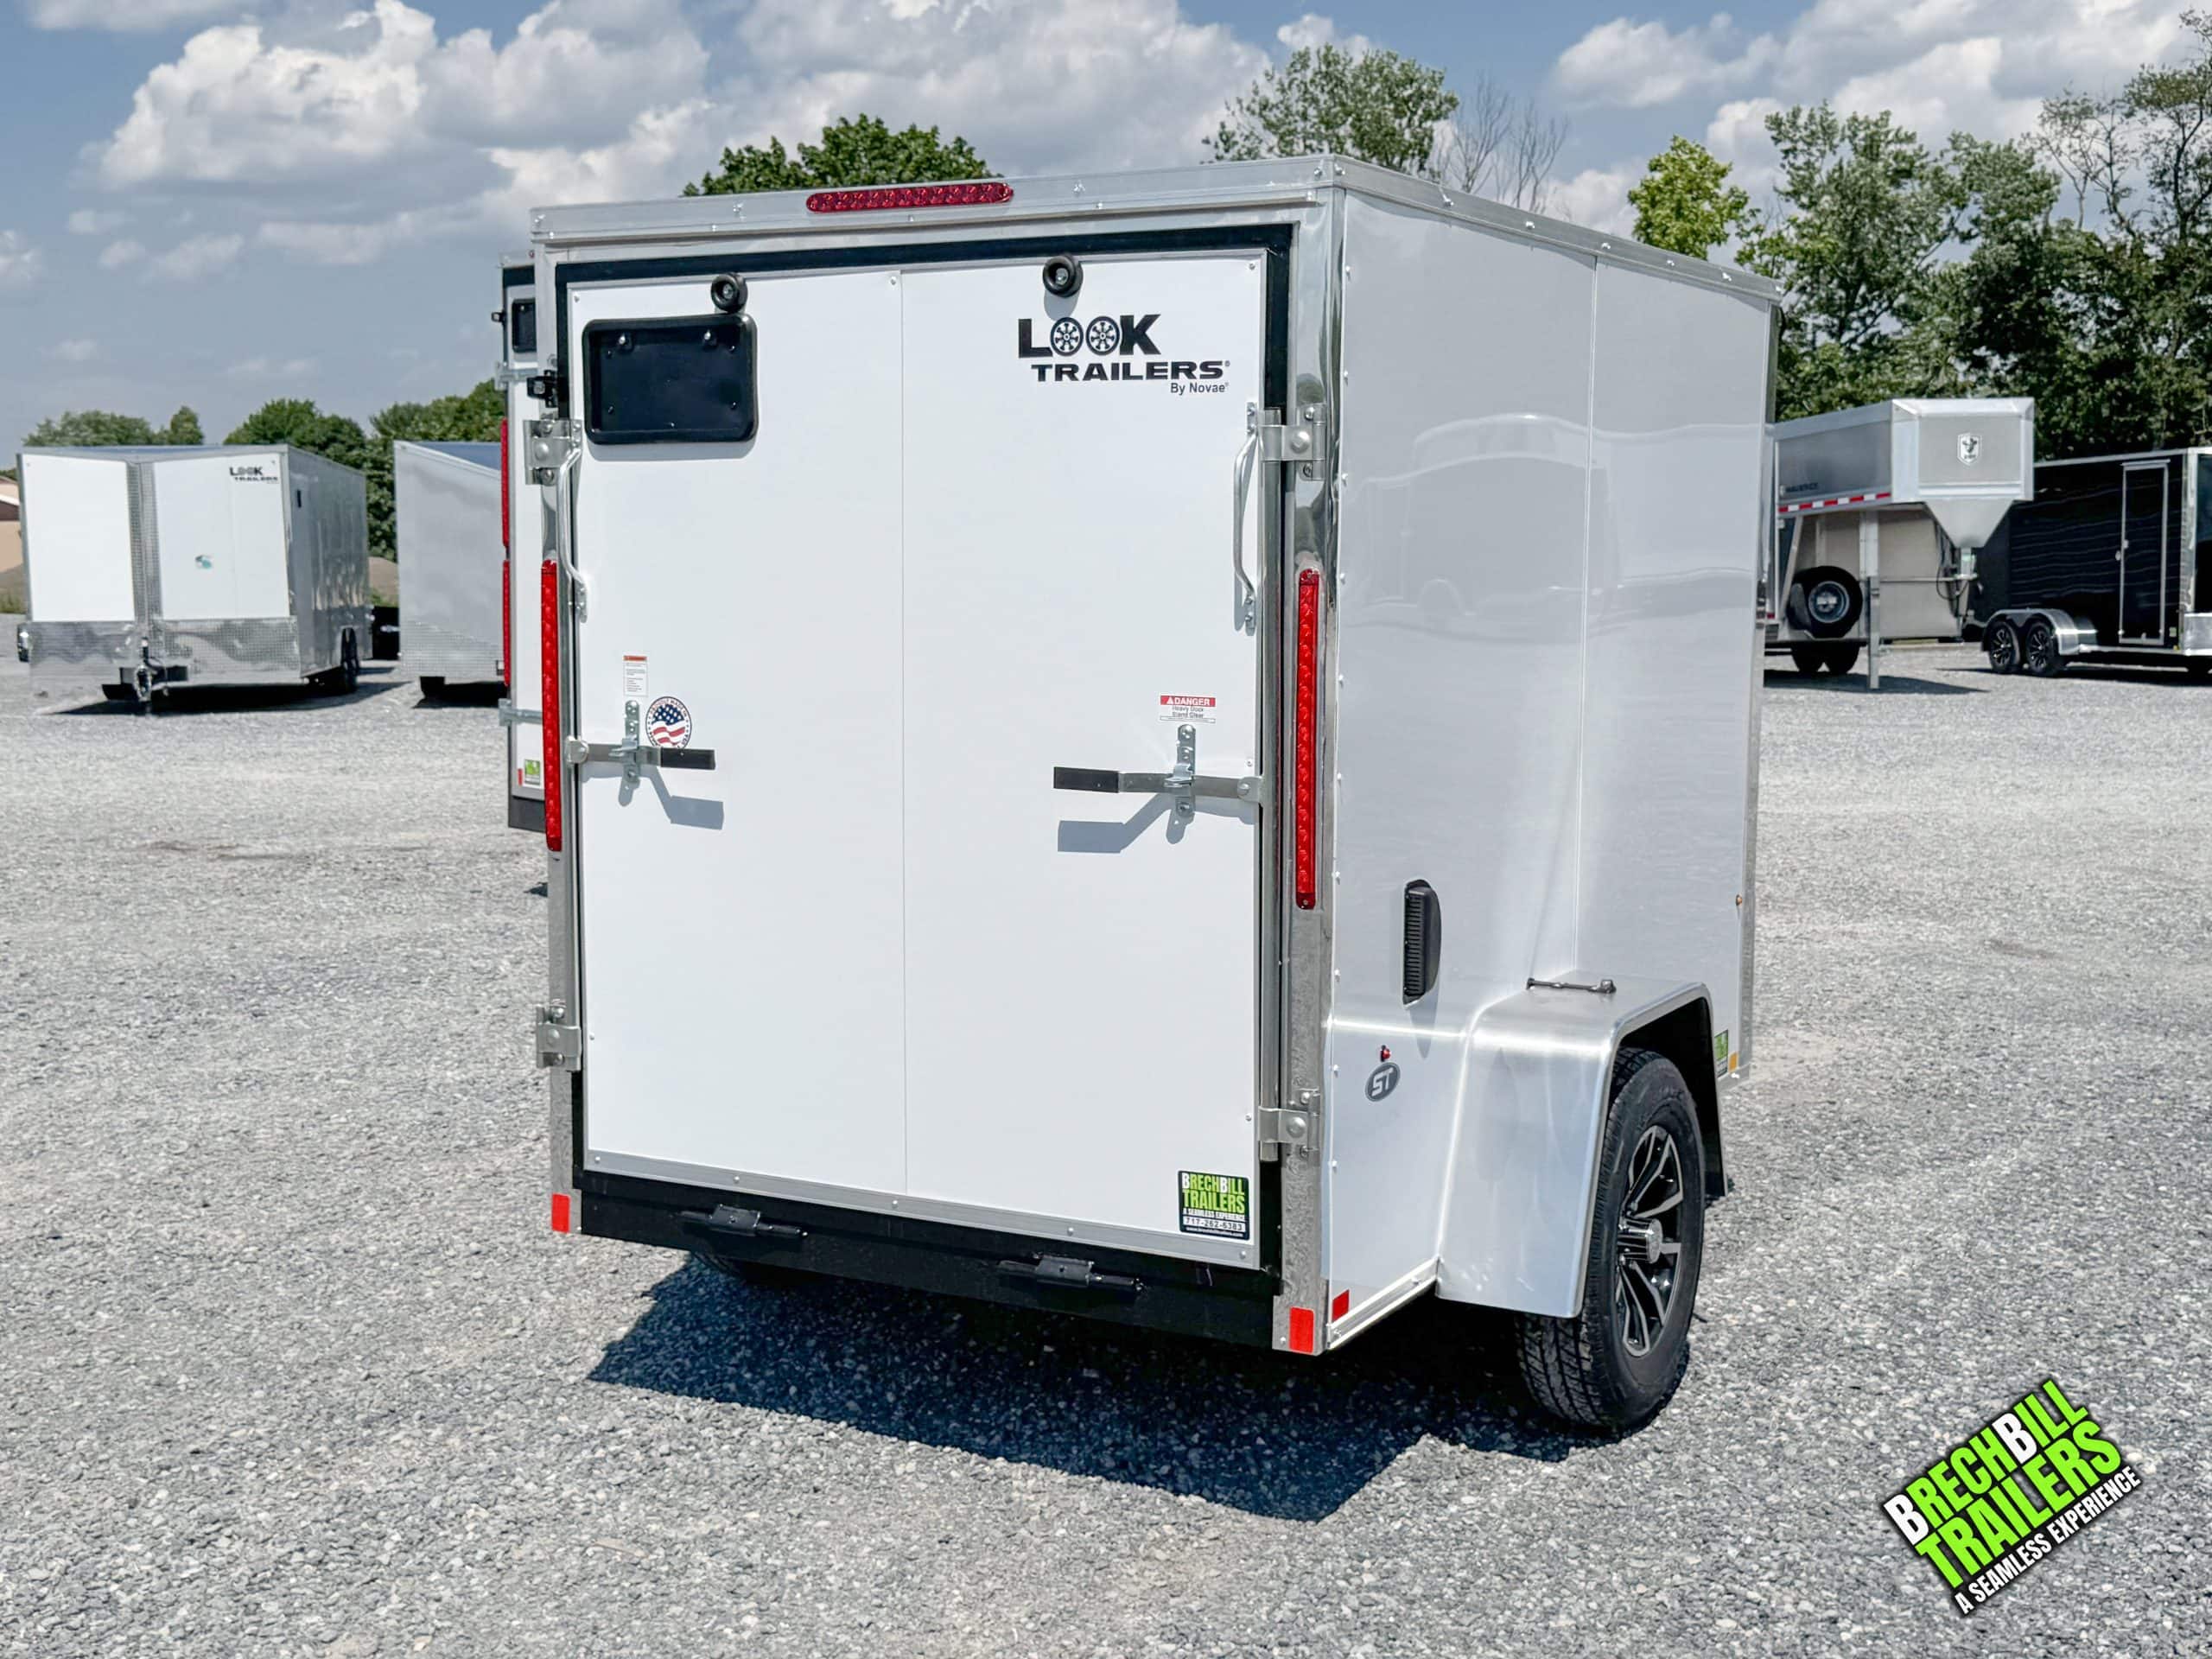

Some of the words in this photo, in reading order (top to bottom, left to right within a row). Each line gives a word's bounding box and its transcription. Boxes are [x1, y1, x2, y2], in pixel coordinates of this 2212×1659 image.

[1018, 314, 1161, 359] LOOK
[1171, 383, 1185, 395] By
[1174, 696, 1211, 706] DANGER
[1371, 1067, 1394, 1096] ST
[1181, 1172, 1245, 1196] BRECHBILL
[1182, 1189, 1245, 1214] TRAILERS
